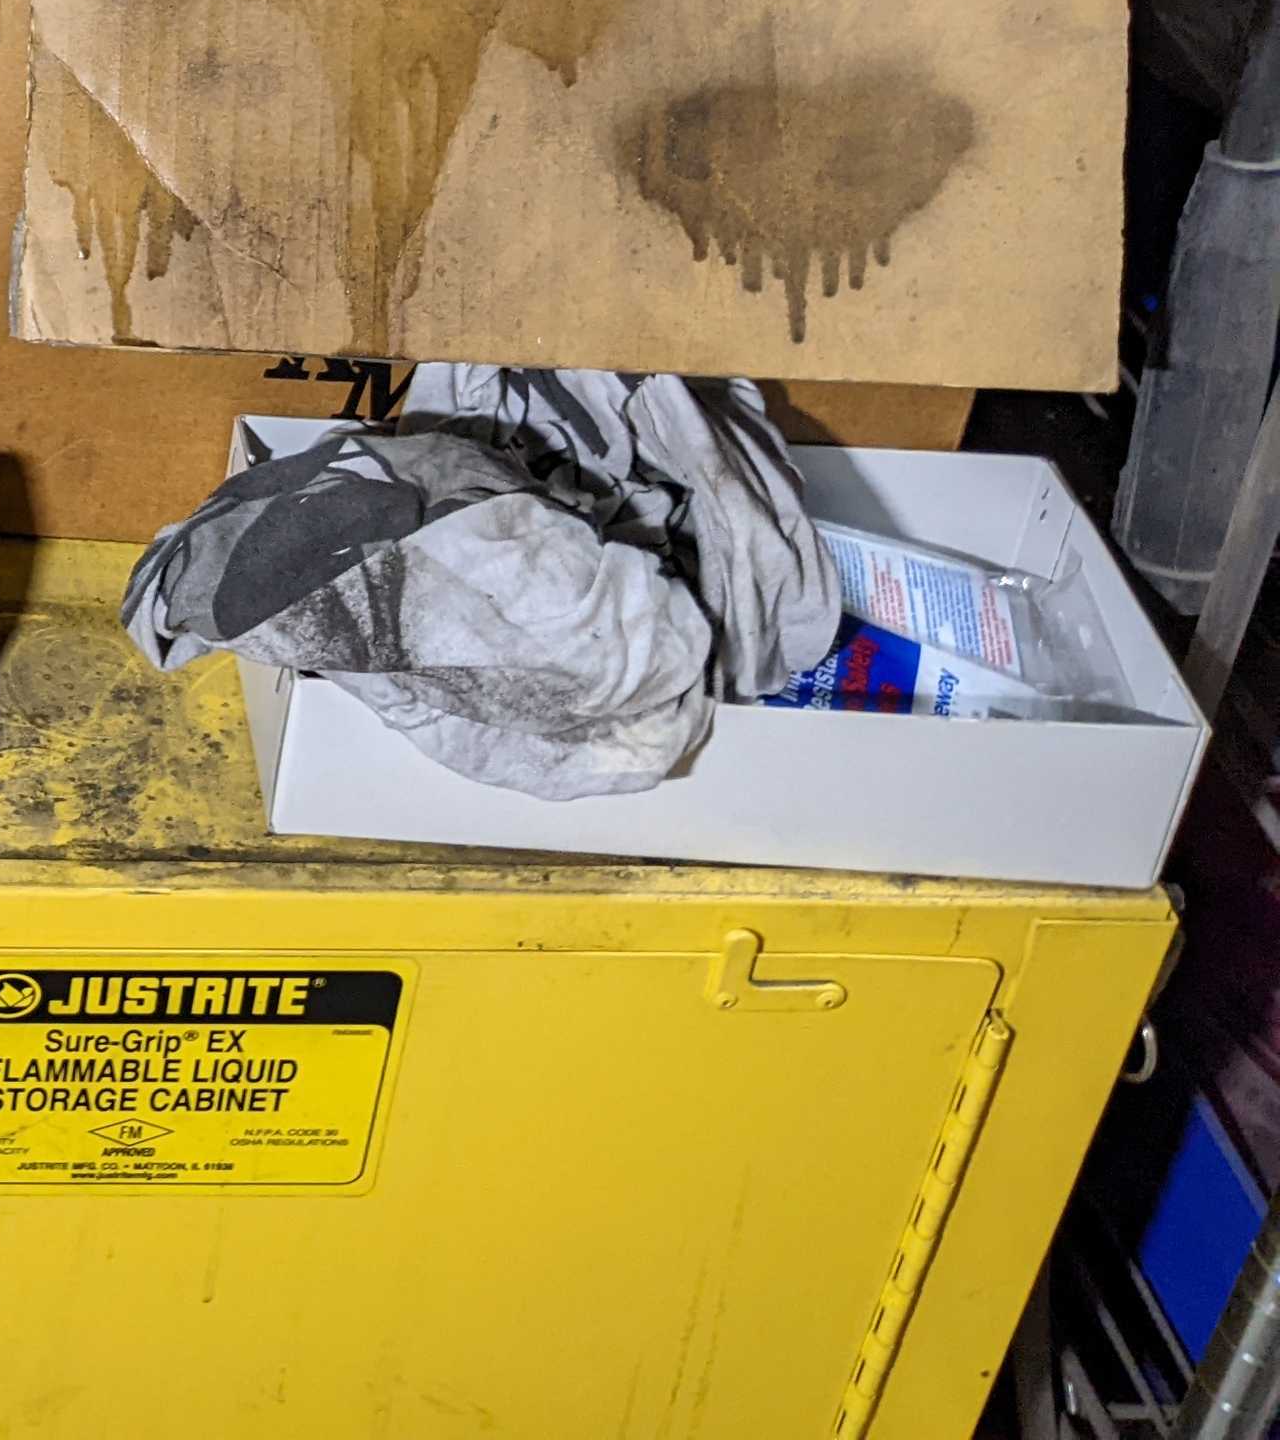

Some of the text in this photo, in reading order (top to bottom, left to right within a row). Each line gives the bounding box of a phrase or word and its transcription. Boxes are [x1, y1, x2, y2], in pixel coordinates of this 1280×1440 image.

[206, 1029, 246, 1053] EX
[192, 1059, 298, 1085] LIQUID
[148, 1087, 290, 1112] CABINET
[118, 1126, 144, 1140] FM
[287, 1128, 323, 1137] CODE
[229, 1138, 350, 1147] OSHA REGULATIONS
[102, 1147, 156, 1158] APPROVED
[17, 1162, 70, 1171] JUSTRITE
